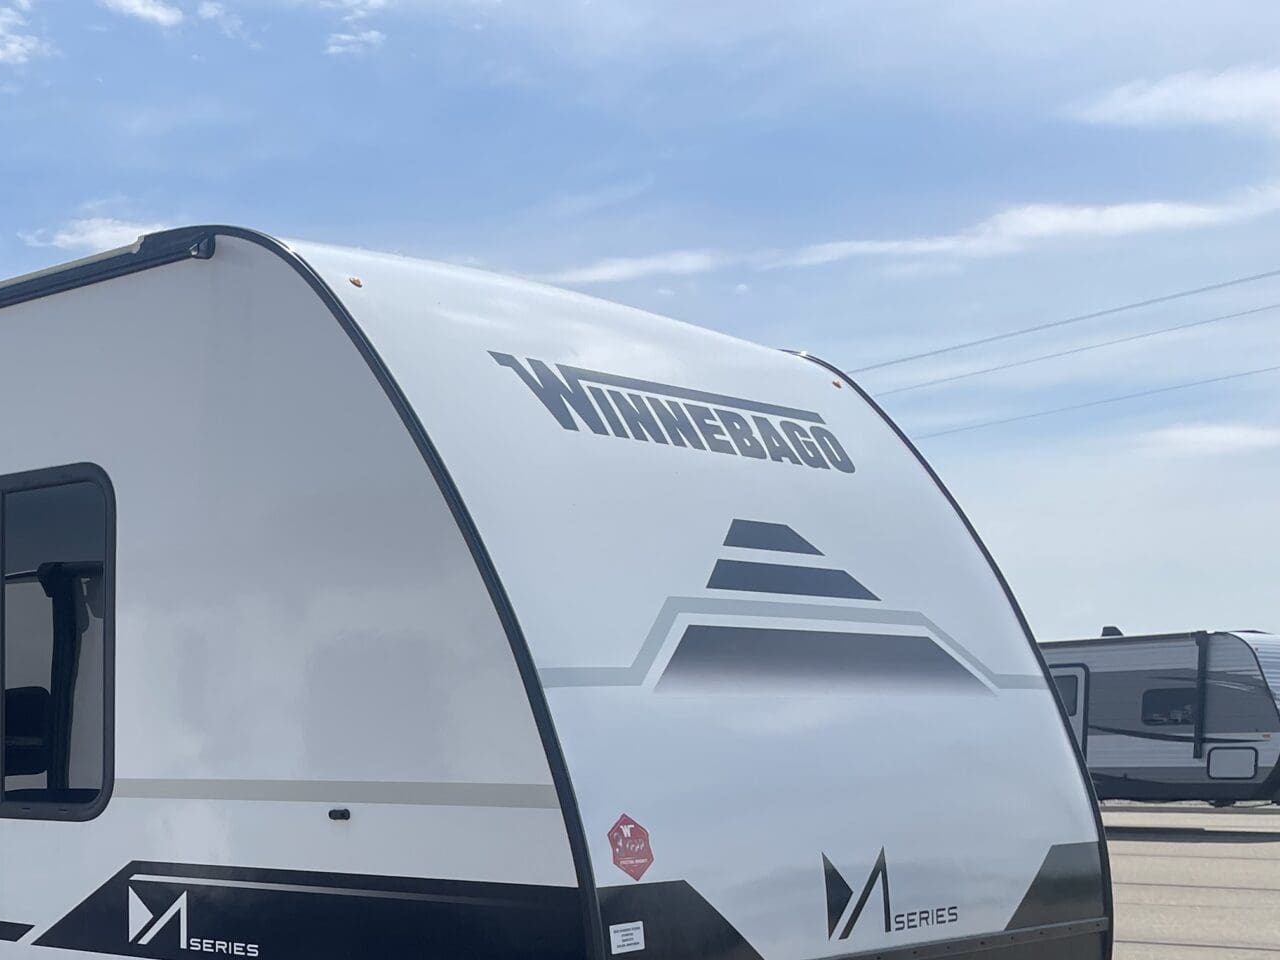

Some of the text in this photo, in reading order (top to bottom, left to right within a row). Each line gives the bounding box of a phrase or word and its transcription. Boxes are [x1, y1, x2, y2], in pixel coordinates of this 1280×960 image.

[486, 350, 856, 474] WINNEBAGO
[894, 906, 958, 931] SERIES
[189, 938, 259, 957] SERIES
